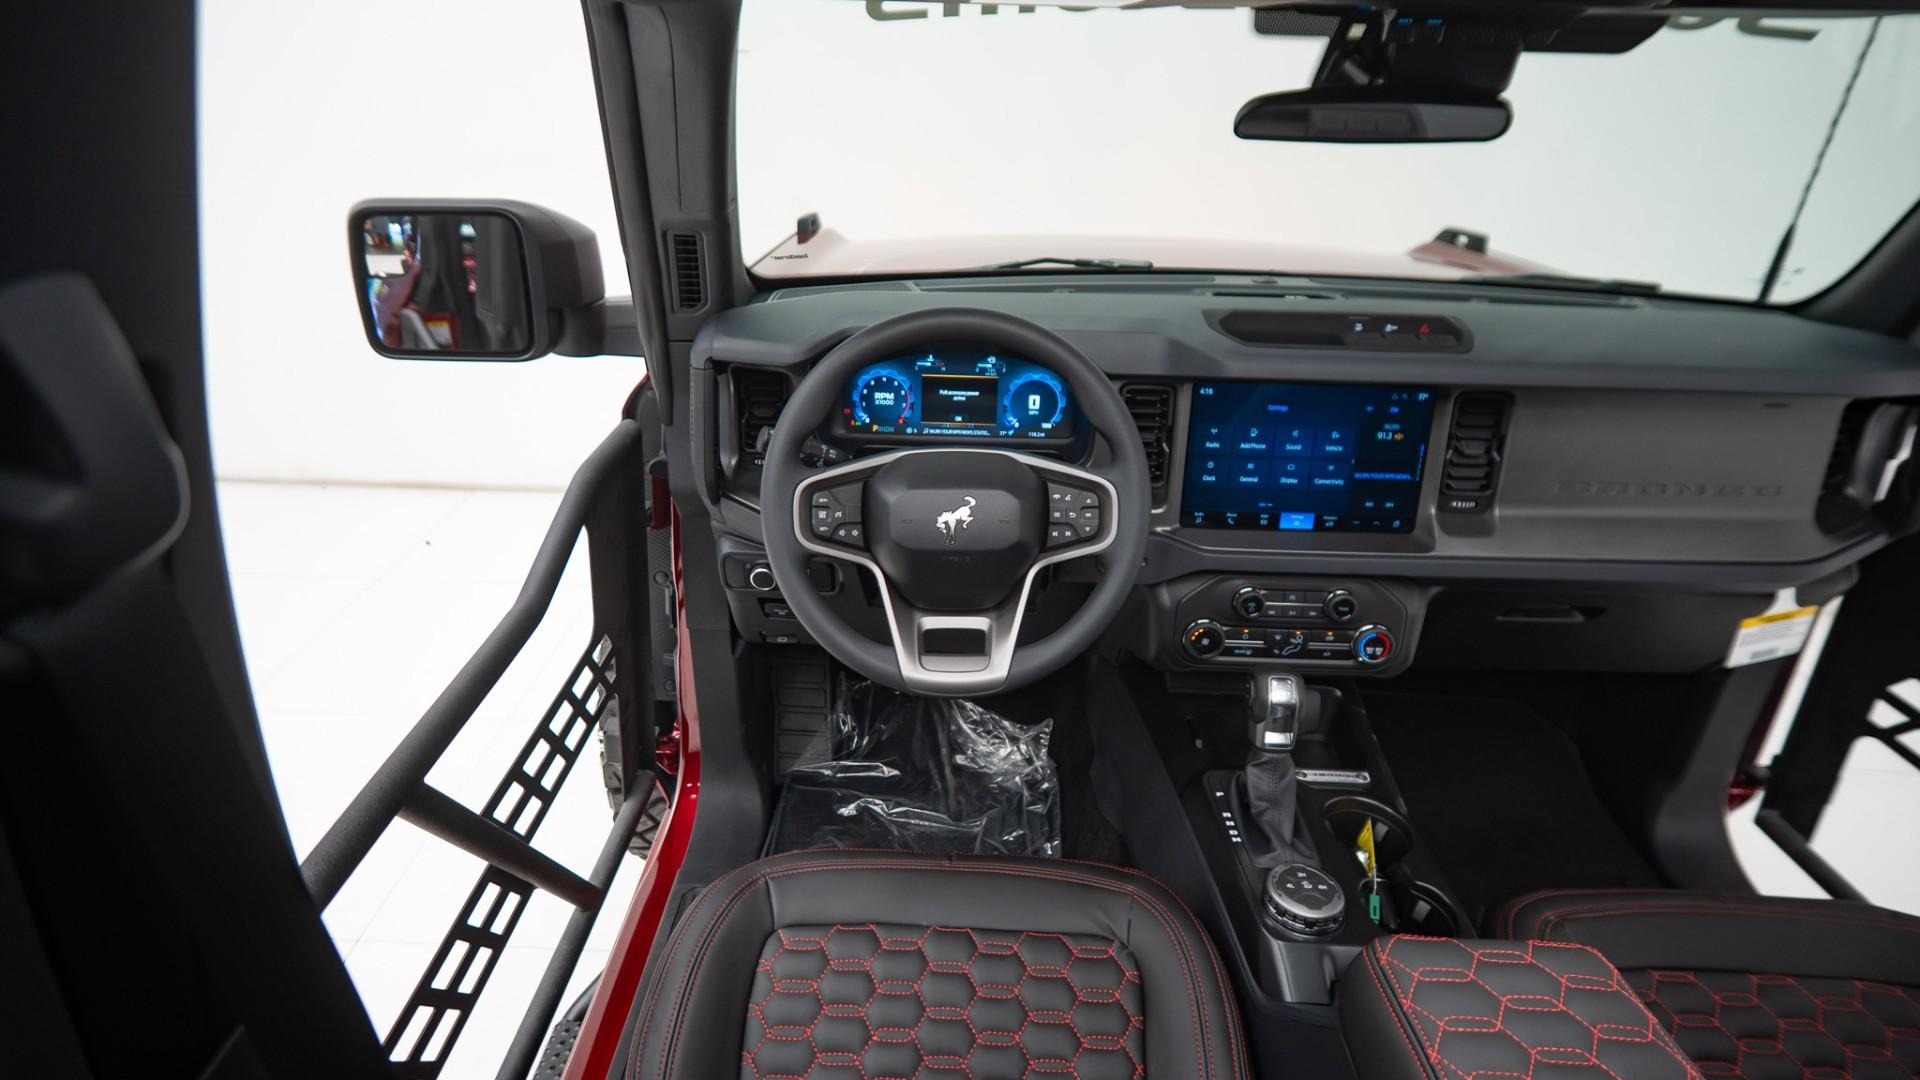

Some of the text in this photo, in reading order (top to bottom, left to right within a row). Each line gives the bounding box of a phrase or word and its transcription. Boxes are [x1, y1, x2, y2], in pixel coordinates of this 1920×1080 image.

[874, 392, 895, 400] RPM
[1028, 394, 1041, 409] 0
[1556, 480, 1782, 497] BRONCO
